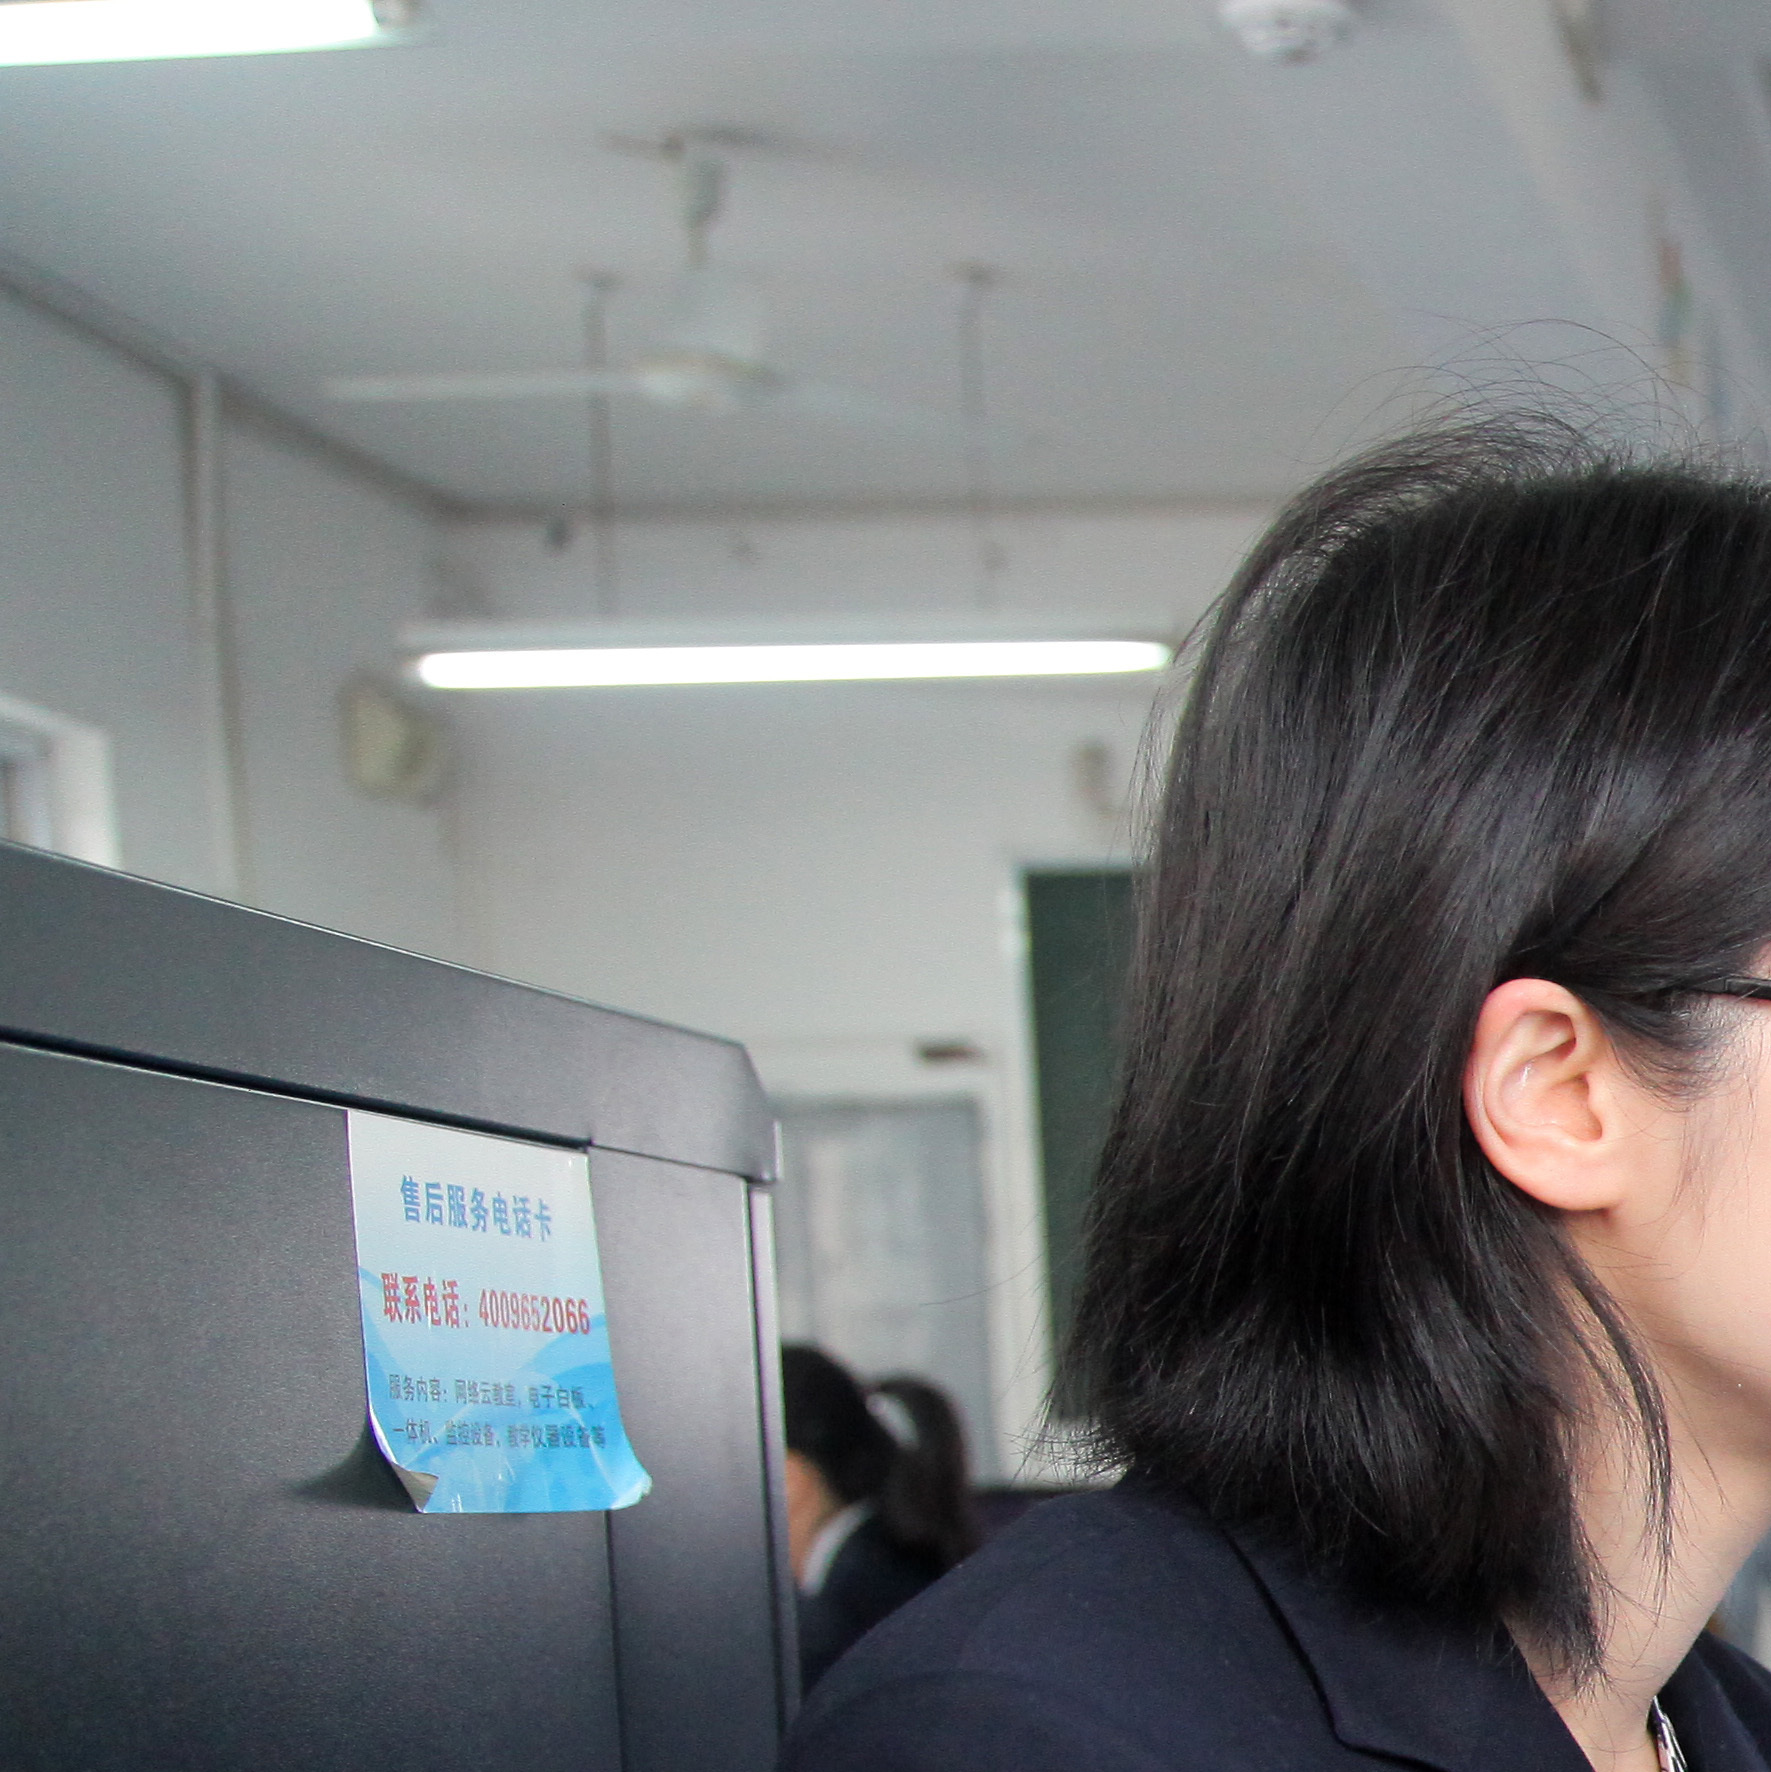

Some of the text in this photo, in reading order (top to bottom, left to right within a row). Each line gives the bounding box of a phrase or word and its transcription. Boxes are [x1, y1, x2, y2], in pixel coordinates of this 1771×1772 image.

[400, 1174, 553, 1243] 售后服务电话卡
